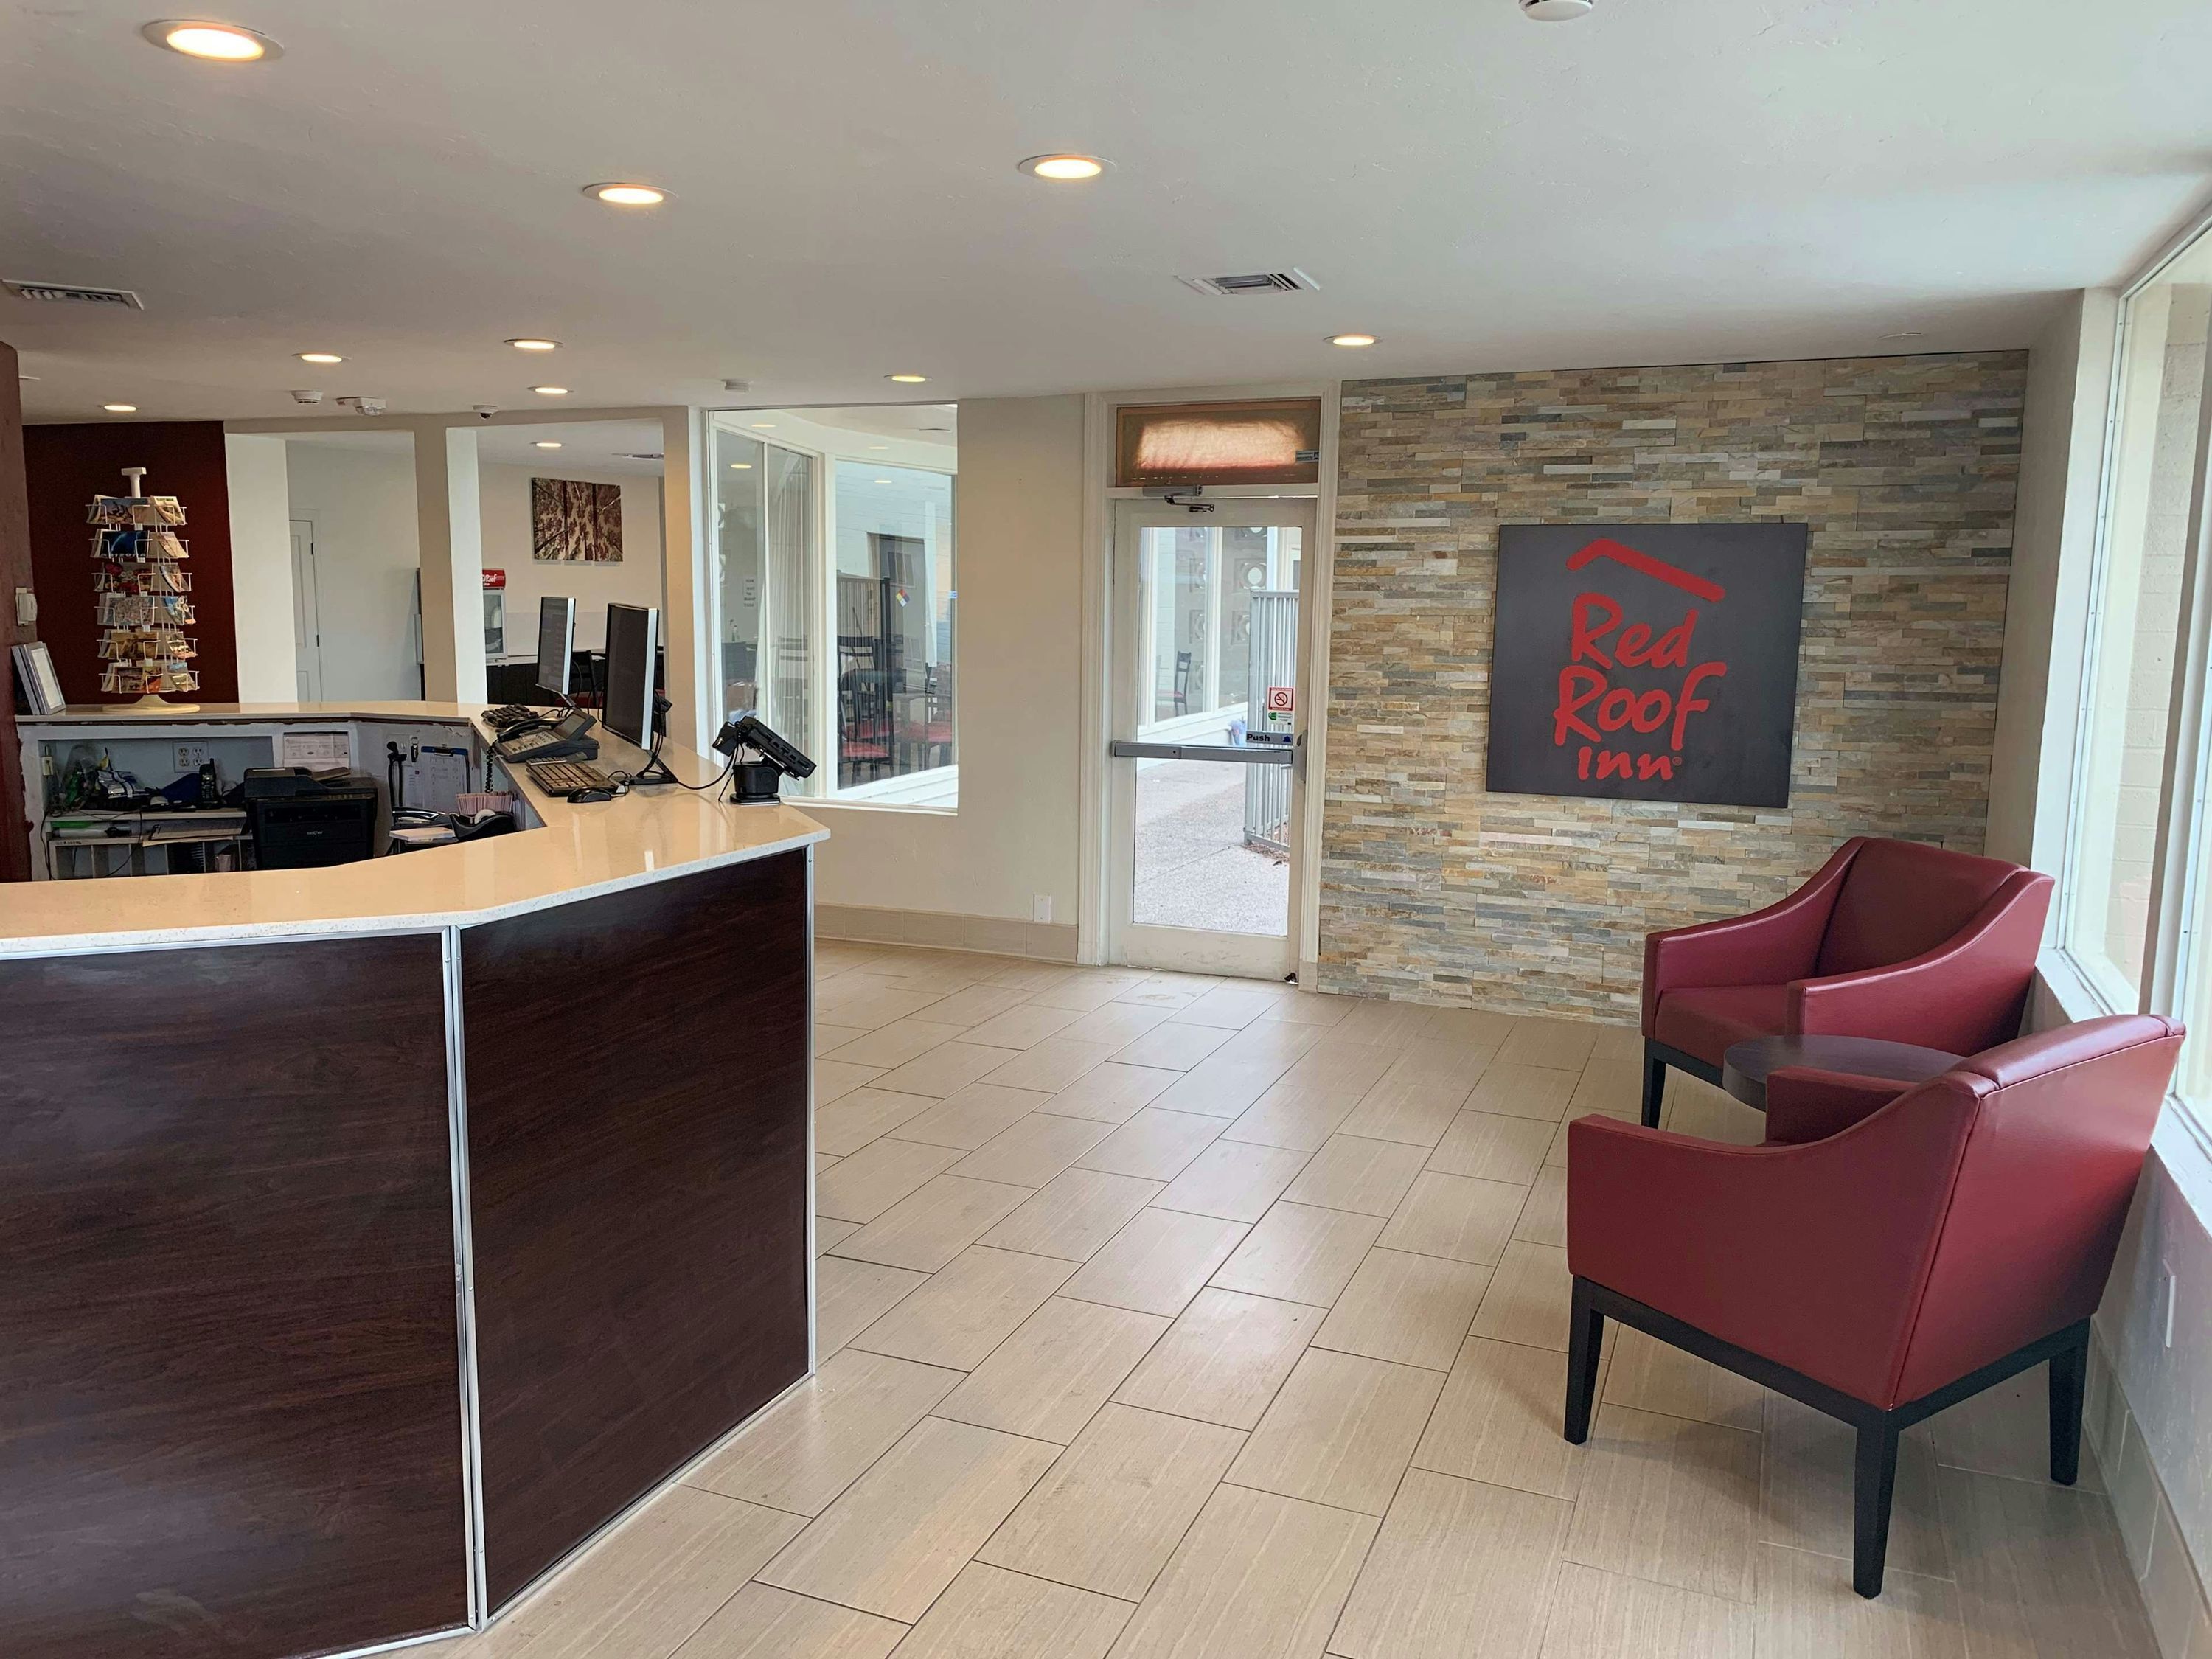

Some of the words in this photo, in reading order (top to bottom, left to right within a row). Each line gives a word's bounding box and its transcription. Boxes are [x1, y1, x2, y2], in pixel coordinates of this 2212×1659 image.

[1571, 592, 1698, 669] Red
[1246, 733, 1270, 742] Push
[1554, 661, 1727, 751] Roof
